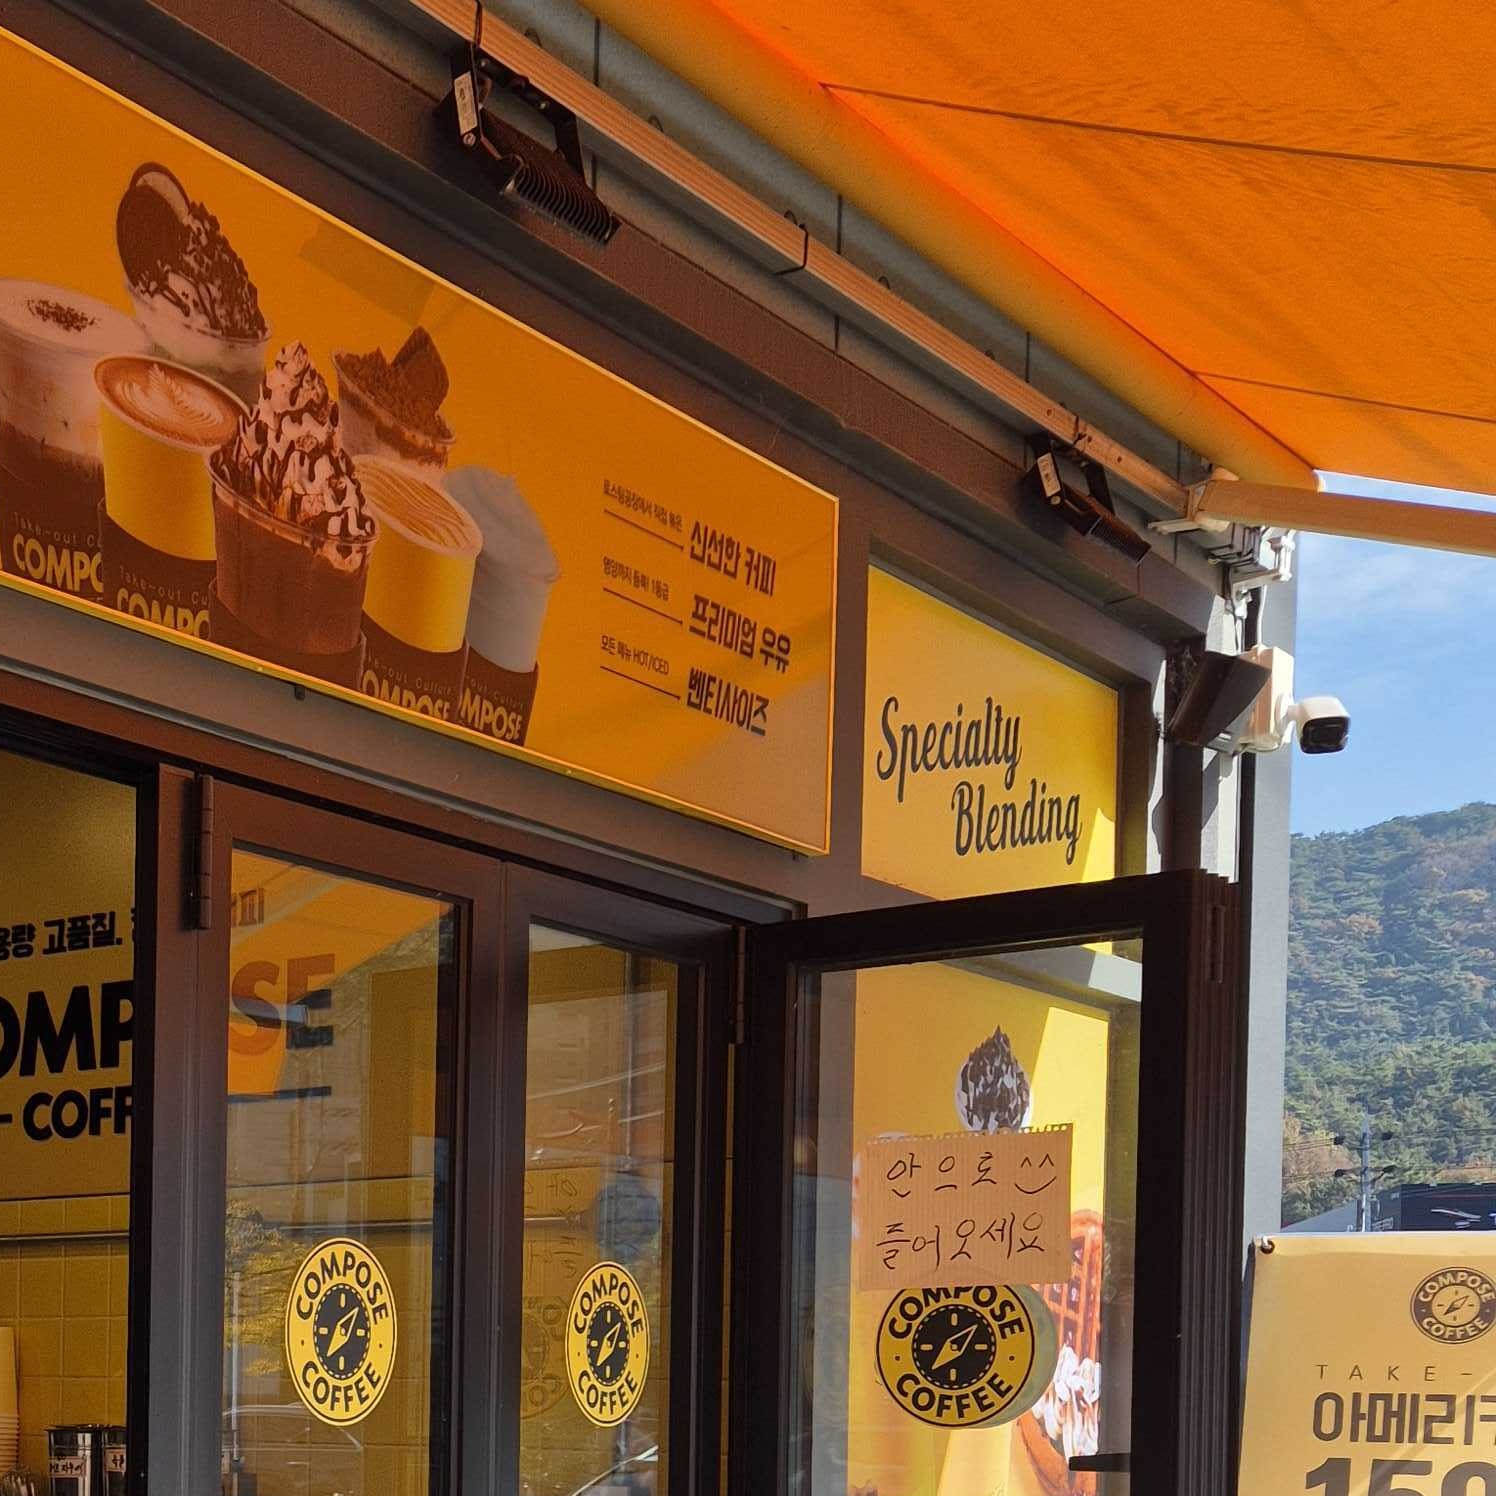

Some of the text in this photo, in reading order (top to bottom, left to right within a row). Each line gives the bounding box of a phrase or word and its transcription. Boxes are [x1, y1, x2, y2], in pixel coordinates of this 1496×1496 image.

[690, 520, 776, 597] 신선한 커피
[689, 593, 791, 674] 프리미엄 우유
[686, 667, 770, 737] 벤티사이즈
[876, 696, 1022, 803] Specialty
[950, 778, 1082, 865] Blending
[886, 1152, 997, 1198] 안으로
[296, 1251, 389, 1325] COMPOSE
[573, 1273, 644, 1339] COMPOSE
[1417, 1270, 1496, 1304] COMPOSE
[1421, 1315, 1489, 1341] COFFEE
[301, 1360, 382, 1413] COFFEE
[577, 1371, 638, 1416] COFFEE
[895, 1373, 1015, 1419] COFFEE
[1312, 1391, 1496, 1446] 아메리
